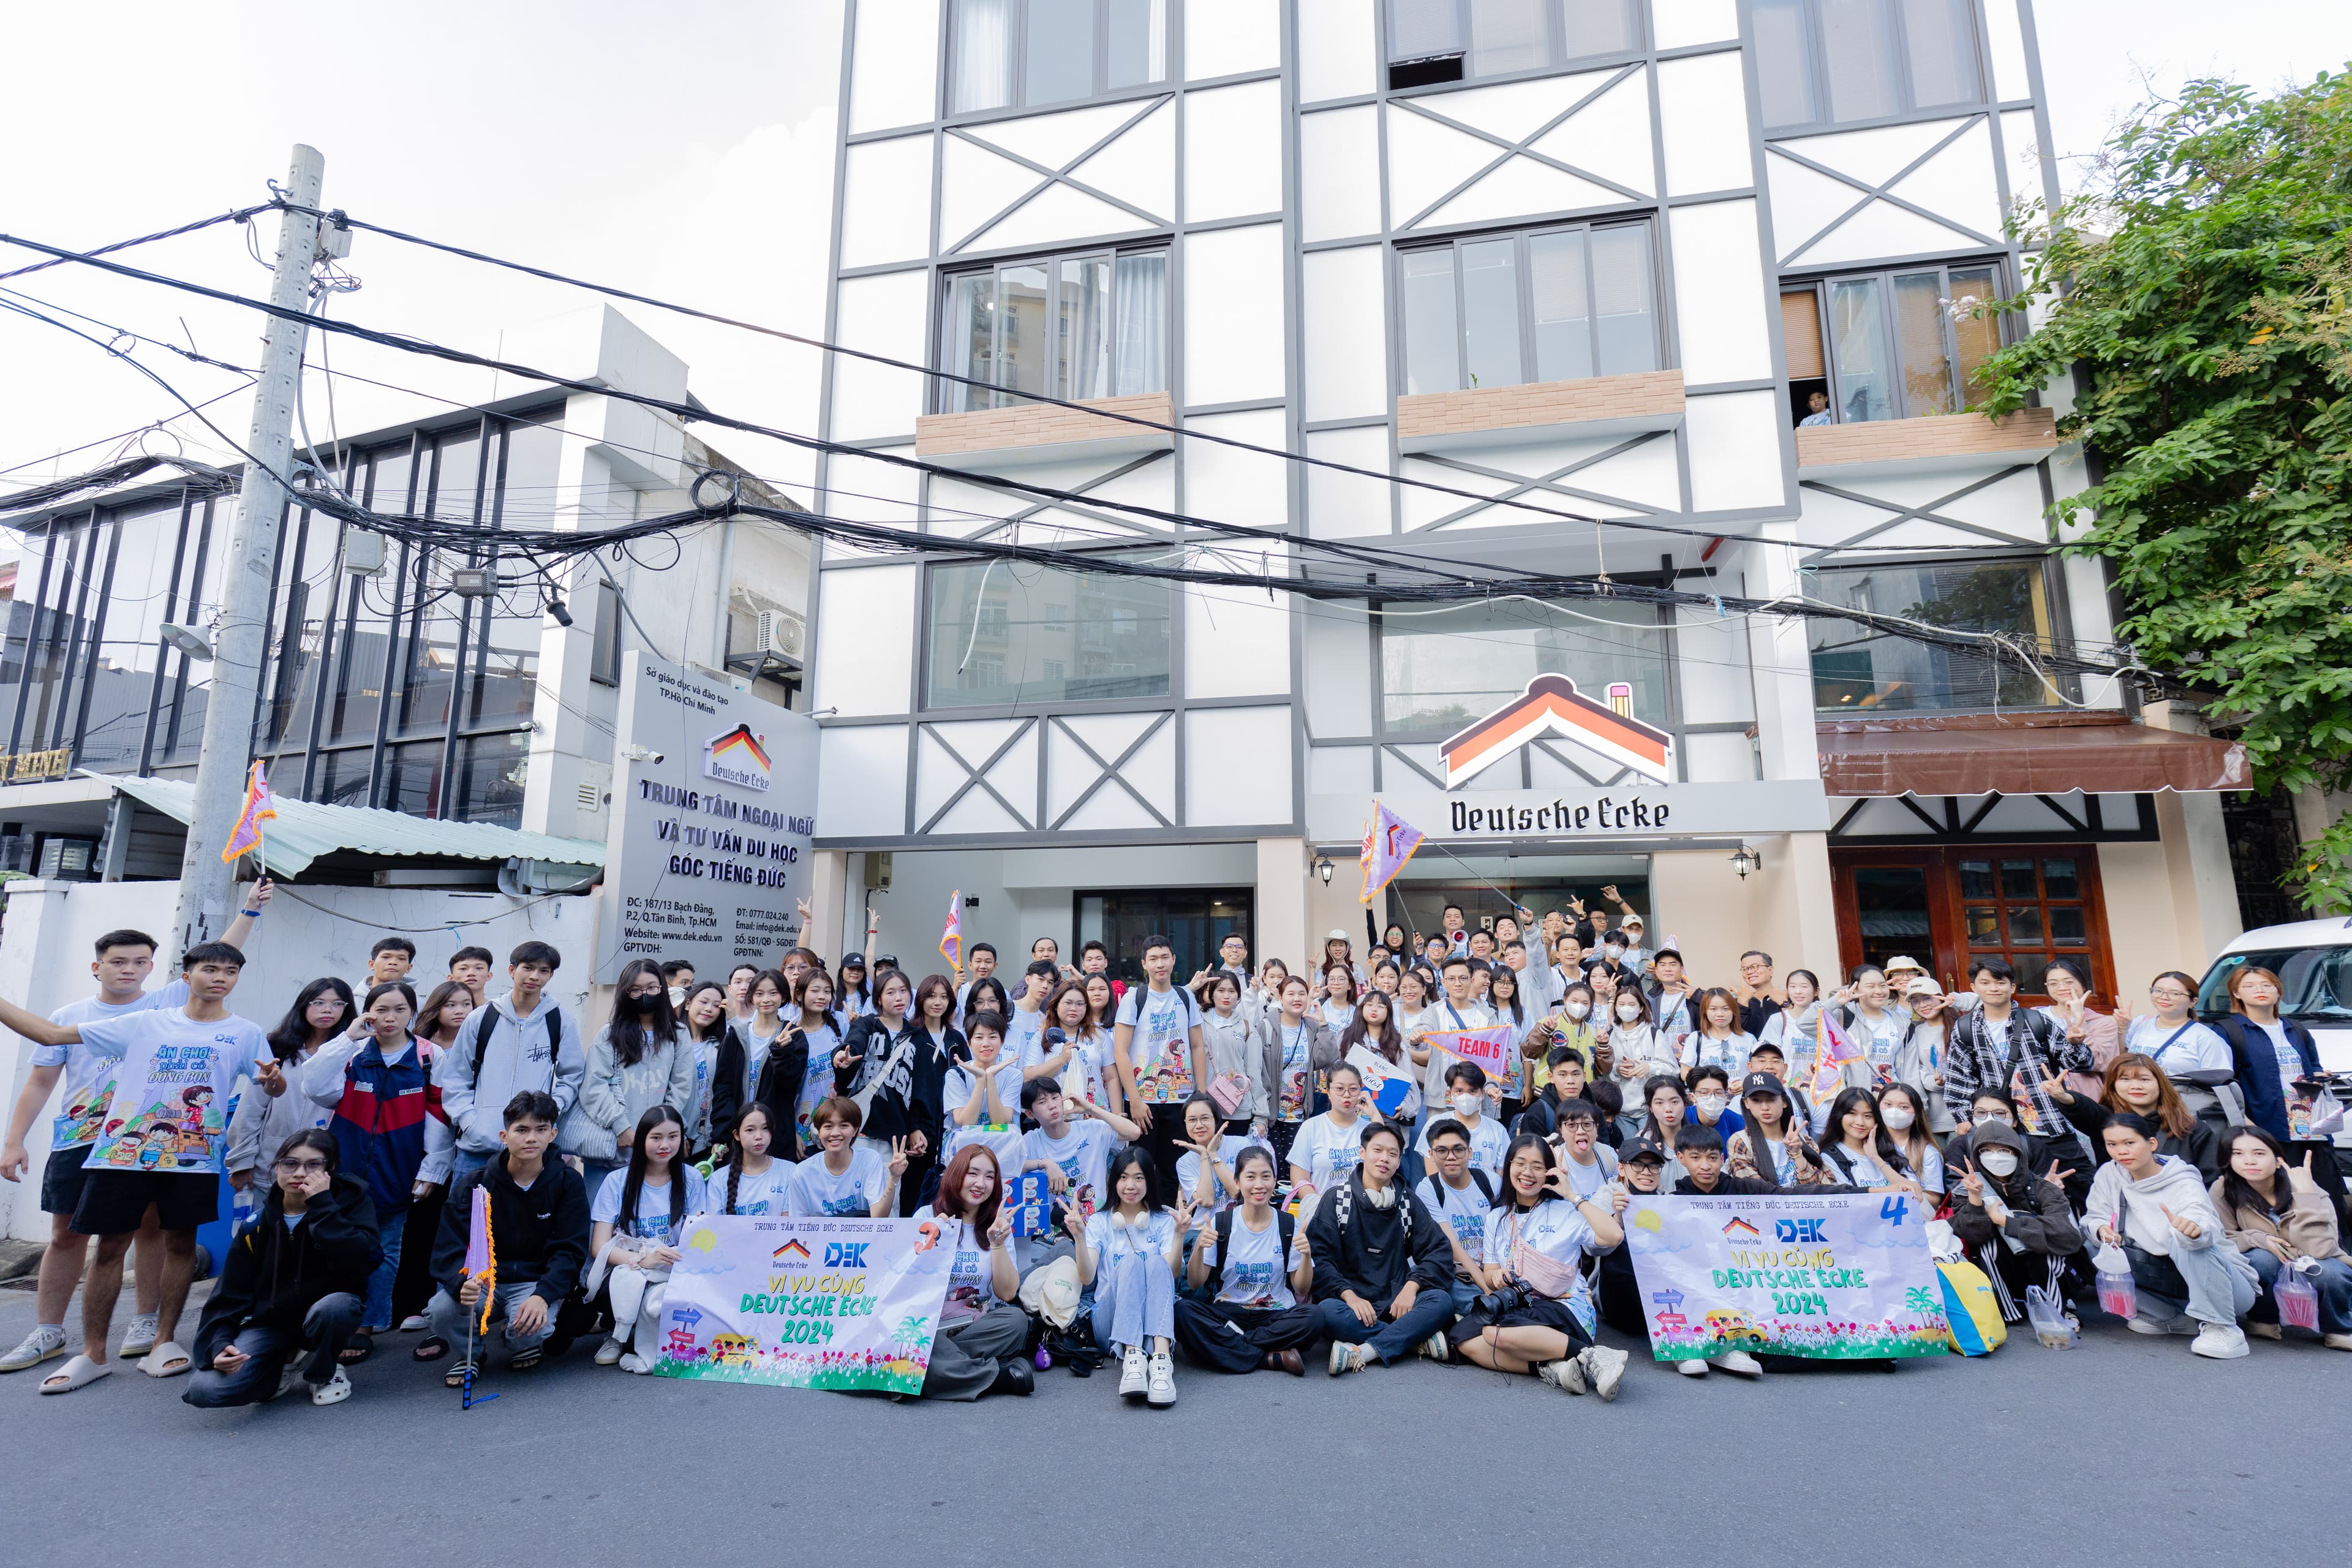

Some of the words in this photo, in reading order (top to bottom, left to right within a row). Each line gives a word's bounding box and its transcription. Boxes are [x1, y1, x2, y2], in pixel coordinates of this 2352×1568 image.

[646, 666, 657, 677] Sở
[658, 673, 675, 685] giáo
[677, 679, 690, 691] dục
[692, 686, 701, 695] và
[703, 689, 715, 700] đào
[717, 695, 729, 706] tạo
[660, 687, 682, 703] TP.Hồ
[684, 696, 695, 708] Chí
[698, 701, 715, 715] Minh
[713, 761, 749, 784] Deutsche
[752, 773, 769, 790] Ecke
[640, 779, 698, 810] TRUNG
[704, 794, 737, 819] TÂM
[741, 804, 783, 832] NGOẠI
[787, 815, 814, 836] NGỮ
[1450, 798, 1589, 832] Deutsche
[1597, 796, 1669, 829] Ecke
[657, 818, 680, 842] VÀ
[685, 826, 707, 846] TƯ
[711, 828, 742, 853] VẤN
[746, 838, 766, 858] DU
[770, 843, 797, 865] HỌC
[669, 853, 703, 877] GÓC
[709, 858, 752, 884] TIẾNG
[756, 866, 786, 888] ĐỨC
[627, 897, 642, 907] ĐC:
[644, 899, 672, 910] 187/13
[674, 902, 692, 913] Bạch
[643, 912, 665, 923] Q.Tân
[667, 914, 686, 925] Bình,
[688, 916, 717, 928] Tp.HCM
[736, 908, 748, 917] ĐT:
[749, 909, 789, 921] 0777.024.240
[736, 921, 755, 930] Email:
[756, 922, 802, 933] info@dek.edu.v
[624, 927, 660, 939] Website:
[662, 932, 722, 942] www.dek.edu.vn
[735, 933, 746, 944] SỐ:
[747, 936, 771, 946] 581/QĐ
[776, 938, 797, 947] SGDĐT
[624, 942, 662, 953] GPTVDH:
[734, 948, 764, 957] GPĐTNN:
[214, 1033, 239, 1046] DEK
[157, 1045, 177, 1059] ĂN
[180, 1046, 213, 1059] CHƠI
[1458, 1037, 1490, 1058] TEAM
[1493, 1043, 1500, 1059] 6
[159, 1059, 189, 1072] phải
[190, 1060, 206, 1070] có
[1374, 1061, 1388, 1072] BLANC
[184, 1071, 212, 1084] BỌN
[1363, 1076, 1382, 1088] 1664
[1329, 1148, 1342, 1159] ĂN
[1071, 1167, 1080, 1176] có
[748, 1200, 769, 1214] CHƠI
[837, 1194, 857, 1210] CHƠI
[1735, 1200, 1760, 1209] TIẾNG
[1765, 1200, 1781, 1209] ĐỨC
[1880, 1196, 1909, 1227] 4
[754, 1223, 777, 1231] TRUNG
[781, 1223, 794, 1231] TÂM
[798, 1223, 820, 1232] TIẾNG
[823, 1223, 836, 1232] ĐỨC
[1452, 1214, 1465, 1229] ĂN
[658, 1226, 669, 1235] có
[1775, 1218, 1830, 1243] DEK
[824, 1243, 871, 1268] DEK
[956, 1251, 979, 1262] CHƠI
[1730, 1250, 1750, 1268] VI
[1751, 1252, 1778, 1268] VU
[1782, 1246, 1834, 1270] CÙNG
[965, 1263, 977, 1273] có
[1235, 1261, 1248, 1274] ĂN
[1251, 1262, 1273, 1274] CHƠI
[769, 1274, 786, 1293] VI
[791, 1275, 815, 1294] VU
[818, 1271, 866, 1297] CÙNG
[960, 1274, 982, 1285] BỌN
[1260, 1275, 1270, 1283] có
[1712, 1268, 1810, 1289] DEUTSCHE
[1815, 1267, 1868, 1289] ECKE
[740, 1294, 835, 1317] DEUTSCHE
[839, 1295, 878, 1317] ECKE
[1771, 1291, 1828, 1316] 2024
[781, 1320, 834, 1344] 2024
